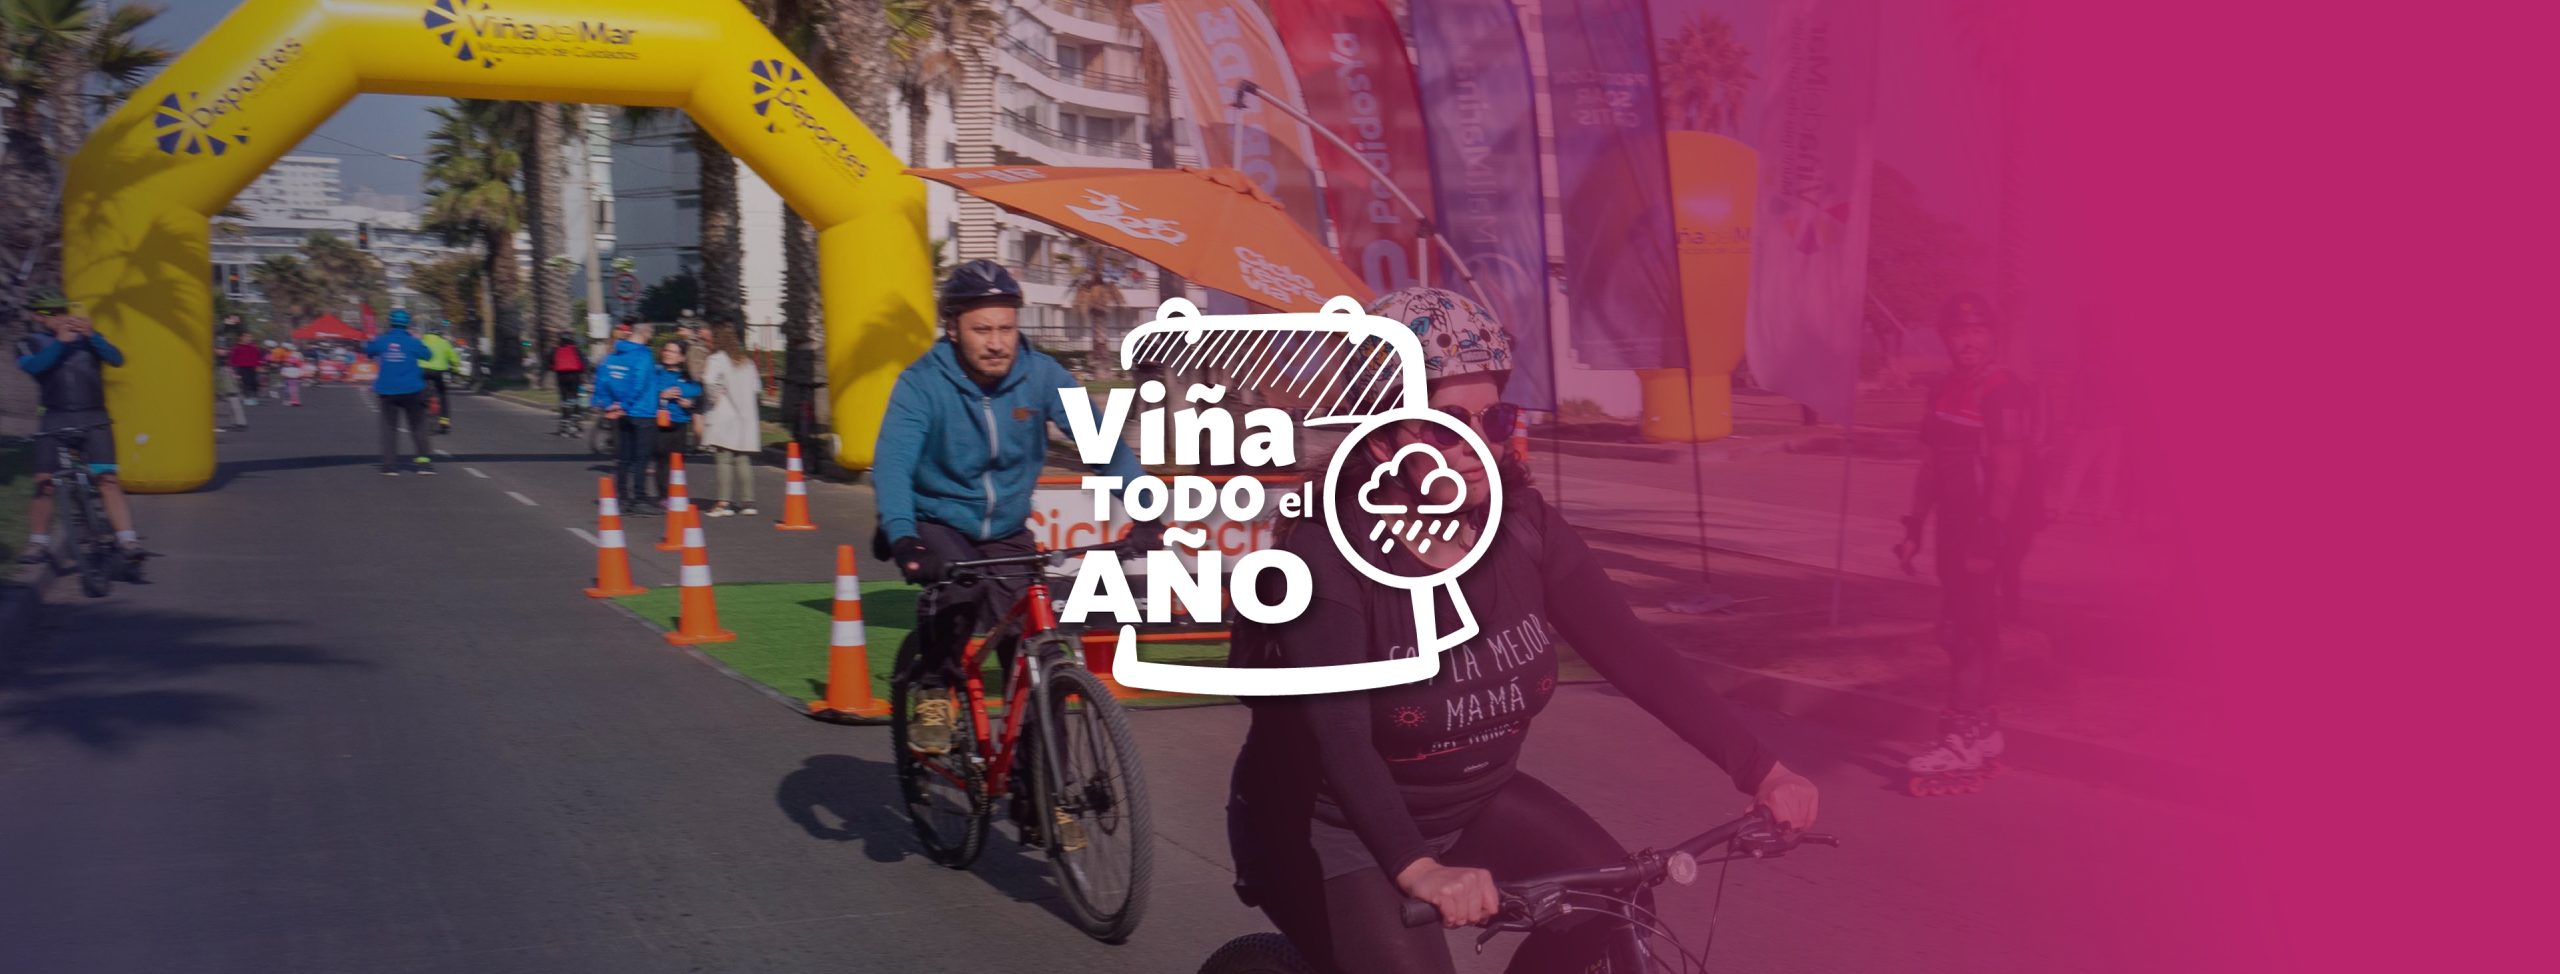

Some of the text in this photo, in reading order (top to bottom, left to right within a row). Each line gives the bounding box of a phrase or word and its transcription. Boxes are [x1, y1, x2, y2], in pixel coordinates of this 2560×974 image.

[188, 38, 302, 129] Deportes
[1329, 32, 1400, 224] PedidosYa
[774, 86, 870, 179] Deportes
[1449, 643, 1482, 683] LA
[1486, 612, 1551, 672] MEJOR
[1446, 676, 1526, 732] MAMÁ
